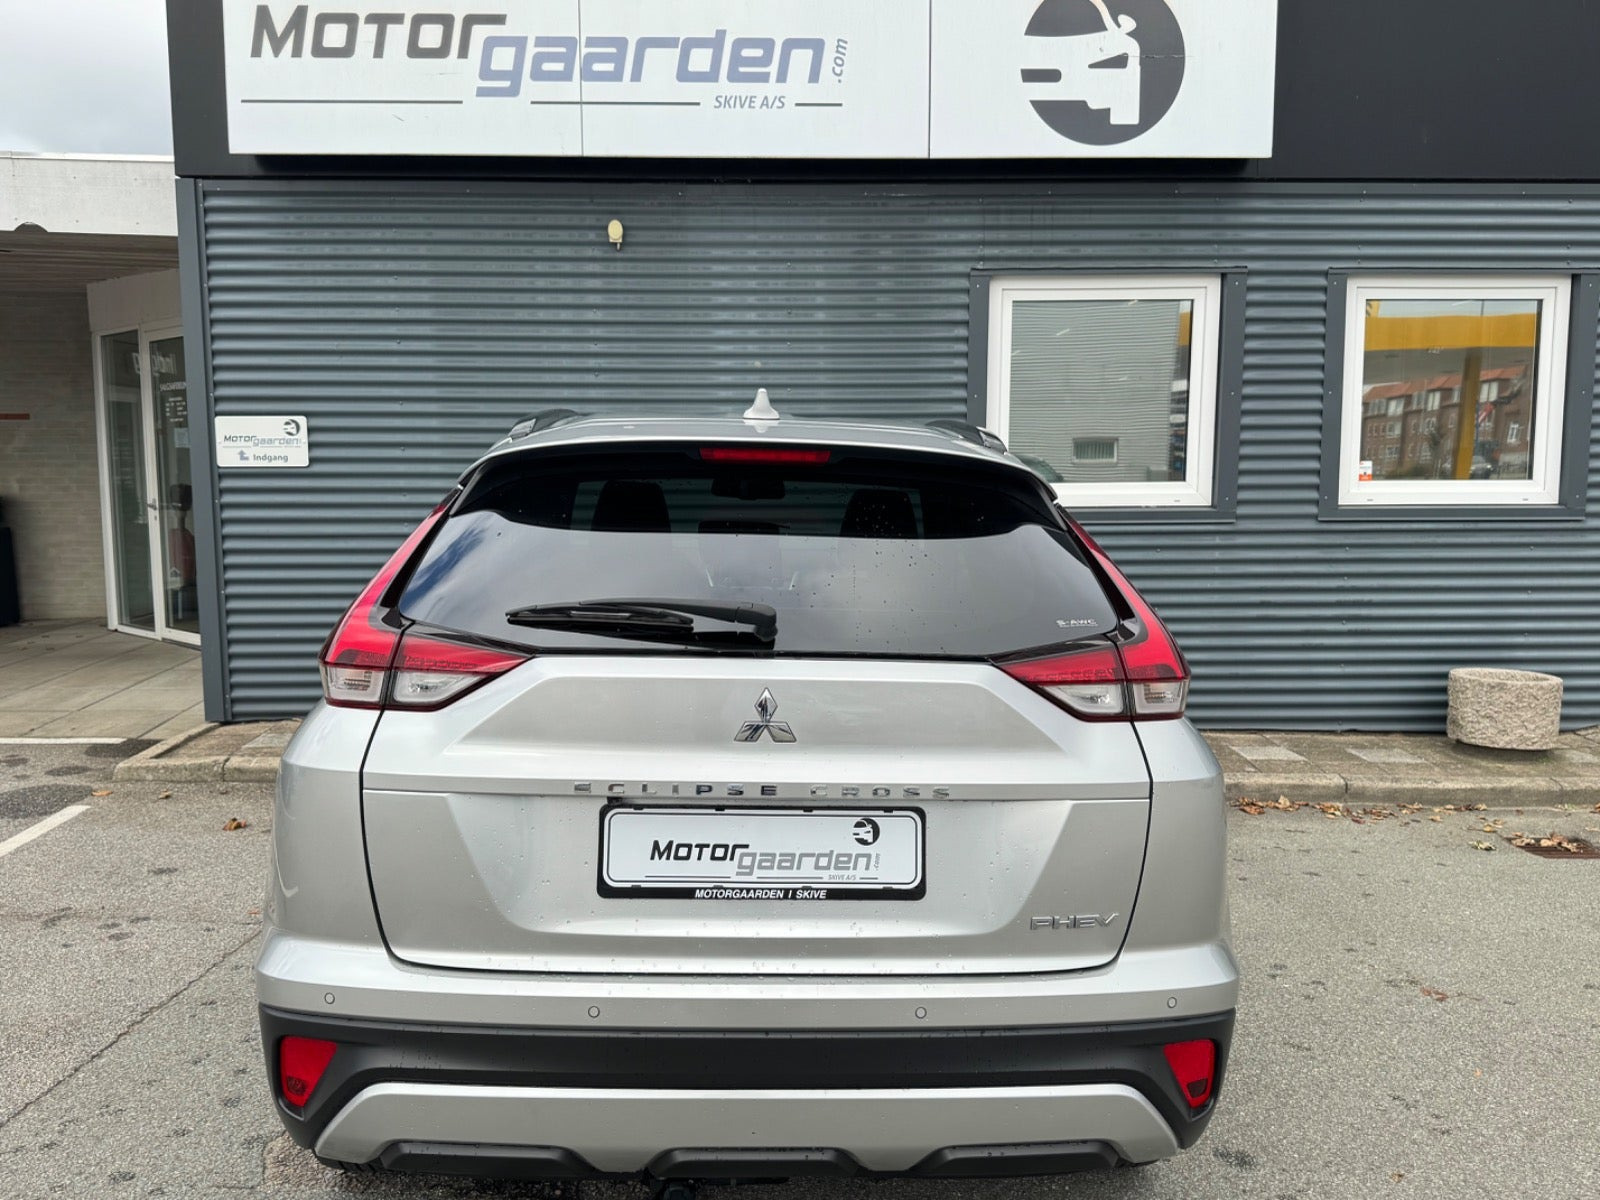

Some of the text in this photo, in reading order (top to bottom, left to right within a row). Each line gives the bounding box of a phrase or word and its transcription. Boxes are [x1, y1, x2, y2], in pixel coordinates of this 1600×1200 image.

[831, 37, 848, 84] .com
[713, 95, 786, 109] SKIVE A/S
[253, 454, 289, 463] Indgang
[573, 782, 950, 799] ECLIPSE CROSS
[694, 889, 785, 899] MOTORGAARDEN
[795, 889, 828, 899] SKIVE
[1030, 912, 1119, 931] PHEV
